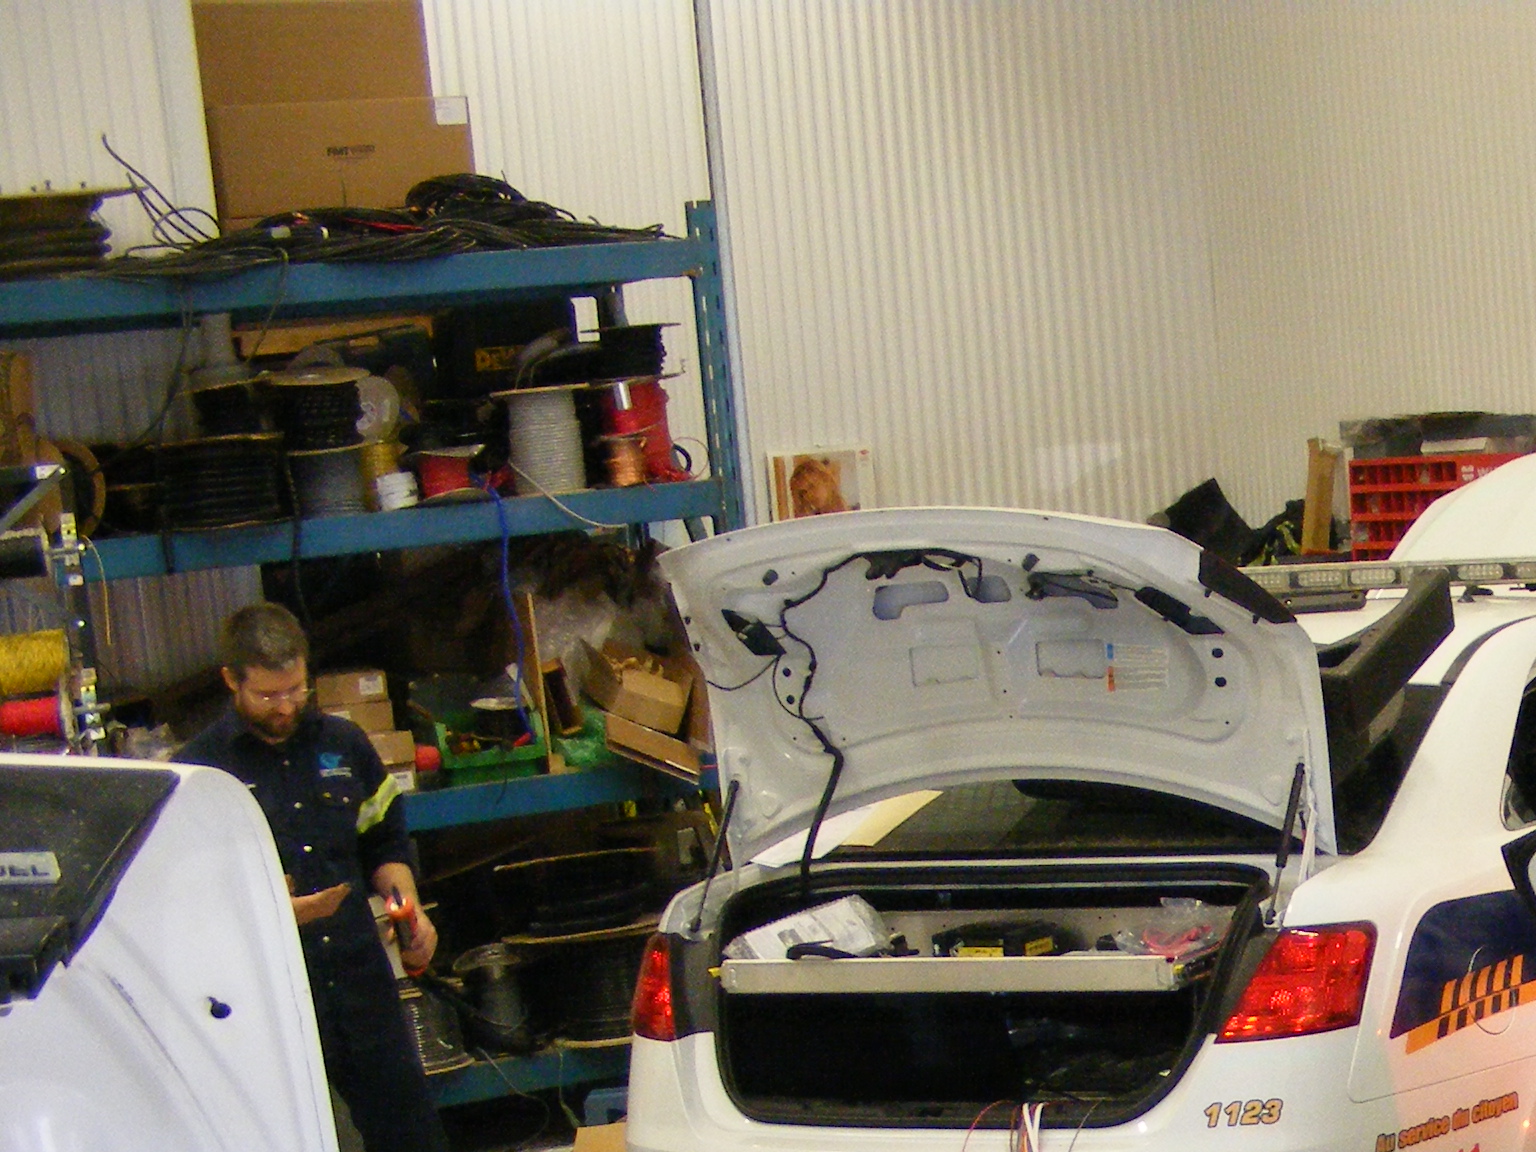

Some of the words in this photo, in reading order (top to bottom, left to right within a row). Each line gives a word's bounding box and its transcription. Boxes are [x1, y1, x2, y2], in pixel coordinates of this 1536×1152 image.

[1204, 1098, 1284, 1128] 1123
[1398, 1115, 1451, 1149] service
[1452, 1107, 1470, 1131] du
[1471, 1091, 1519, 1124] citoyen
